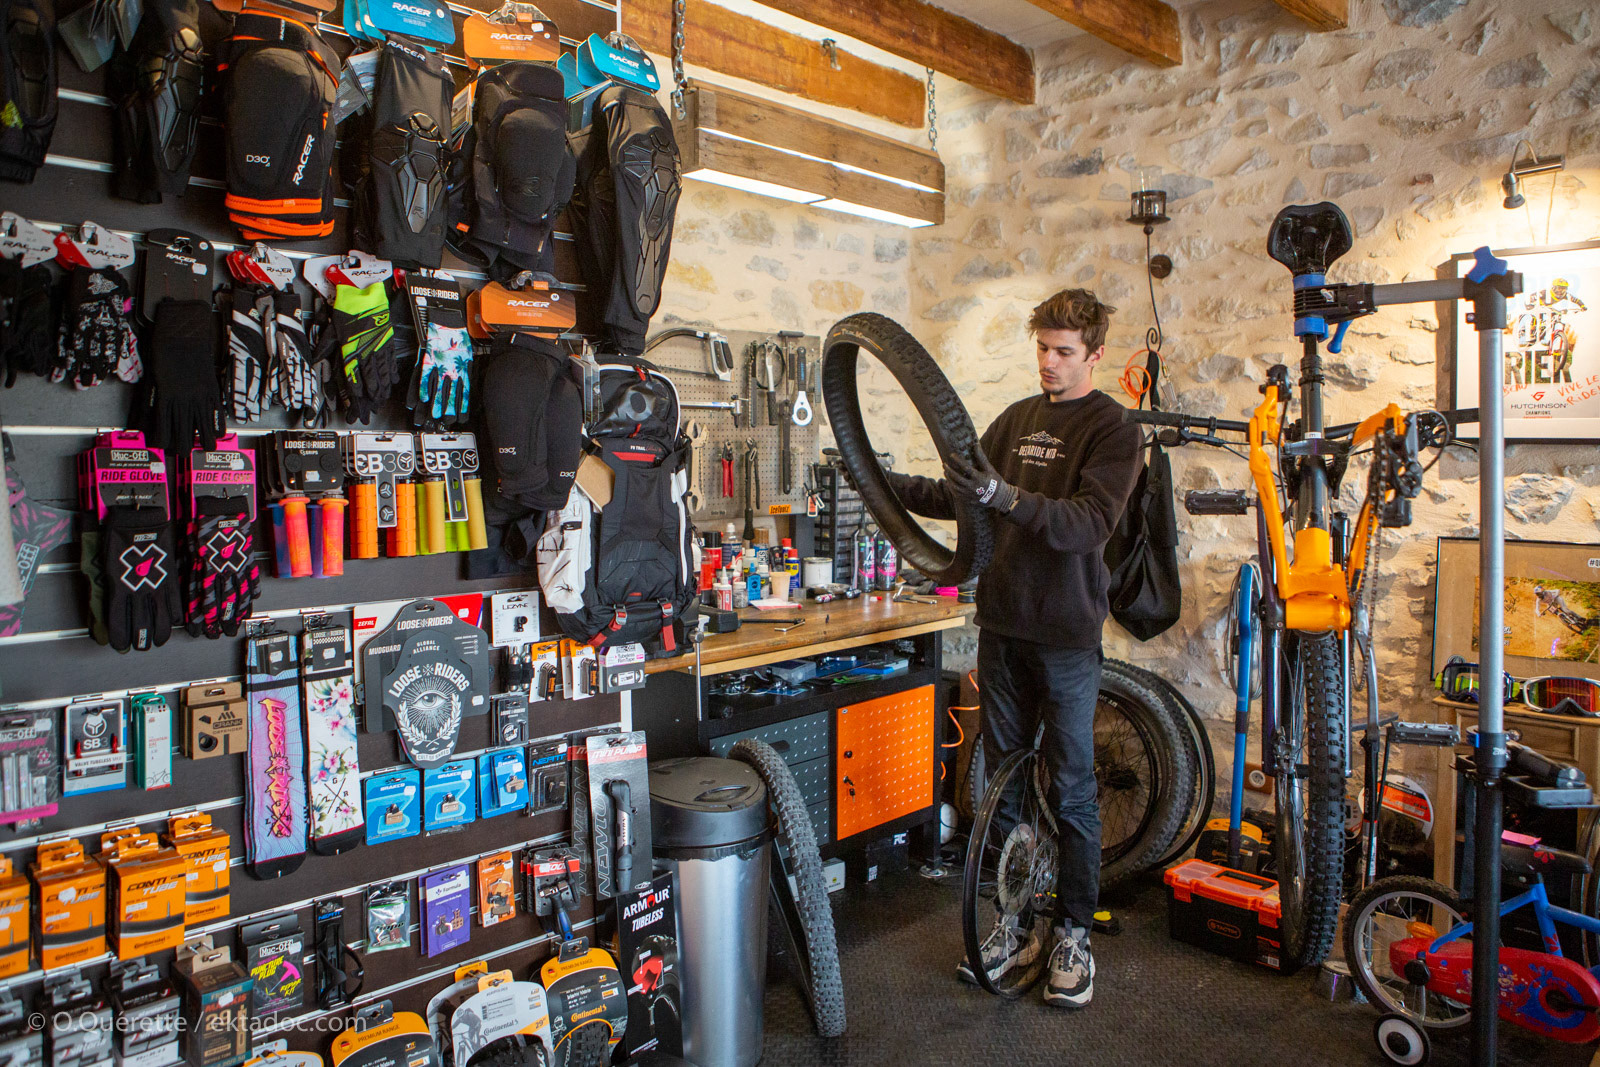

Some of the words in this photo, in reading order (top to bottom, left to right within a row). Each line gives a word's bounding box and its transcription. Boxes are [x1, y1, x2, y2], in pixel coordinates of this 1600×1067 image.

[392, 2, 432, 18] RACER
[490, 32, 533, 42] RACER
[387, 38, 427, 62] RACER
[608, 52, 640, 69] RACER
[292, 134, 316, 186] RACER
[166, 252, 198, 263] RACER
[410, 285, 432, 297] LOOSE
[437, 289, 460, 300] RIDERS
[507, 299, 550, 309] RACER
[284, 440, 306, 449] LOOSE
[312, 440, 336, 449] RIDERS
[112, 450, 149, 461] Muc-Off
[101, 471, 126, 481] RIDE
[129, 471, 163, 481] GLOVE
[195, 472, 218, 482] RIDE
[221, 472, 252, 482] GLOVE
[502, 602, 528, 611] LEZYNE
[397, 619, 420, 631] LOOSE
[427, 615, 454, 628] RIDERS
[329, 629, 345, 637] RIDERS
[256, 638, 270, 647] LOOSE
[273, 635, 289, 645] RIDERS
[368, 643, 402, 656] MUDGUARD
[412, 645, 441, 655] ALLIANCE
[388, 664, 423, 699] LOOSE
[434, 662, 471, 692] RIDERS
[212, 726, 243, 735] DEFENDER
[213, 719, 242, 729] CRANK
[0, 729, 36, 740] uc-Off
[83, 737, 109, 750] SB3
[181, 847, 217, 860] CONTI
[193, 851, 227, 866] TUBE
[127, 876, 168, 892] CONTI
[142, 880, 179, 896] TUBE
[46, 887, 89, 903] CTI
[631, 906, 665, 932] TUBELESS
[258, 966, 277, 981] PLUG
[571, 1004, 603, 1023] Continental
[357, 1030, 383, 1043] PREMIUM
[382, 1024, 400, 1034] RANGE
[483, 1020, 515, 1037] Continental
